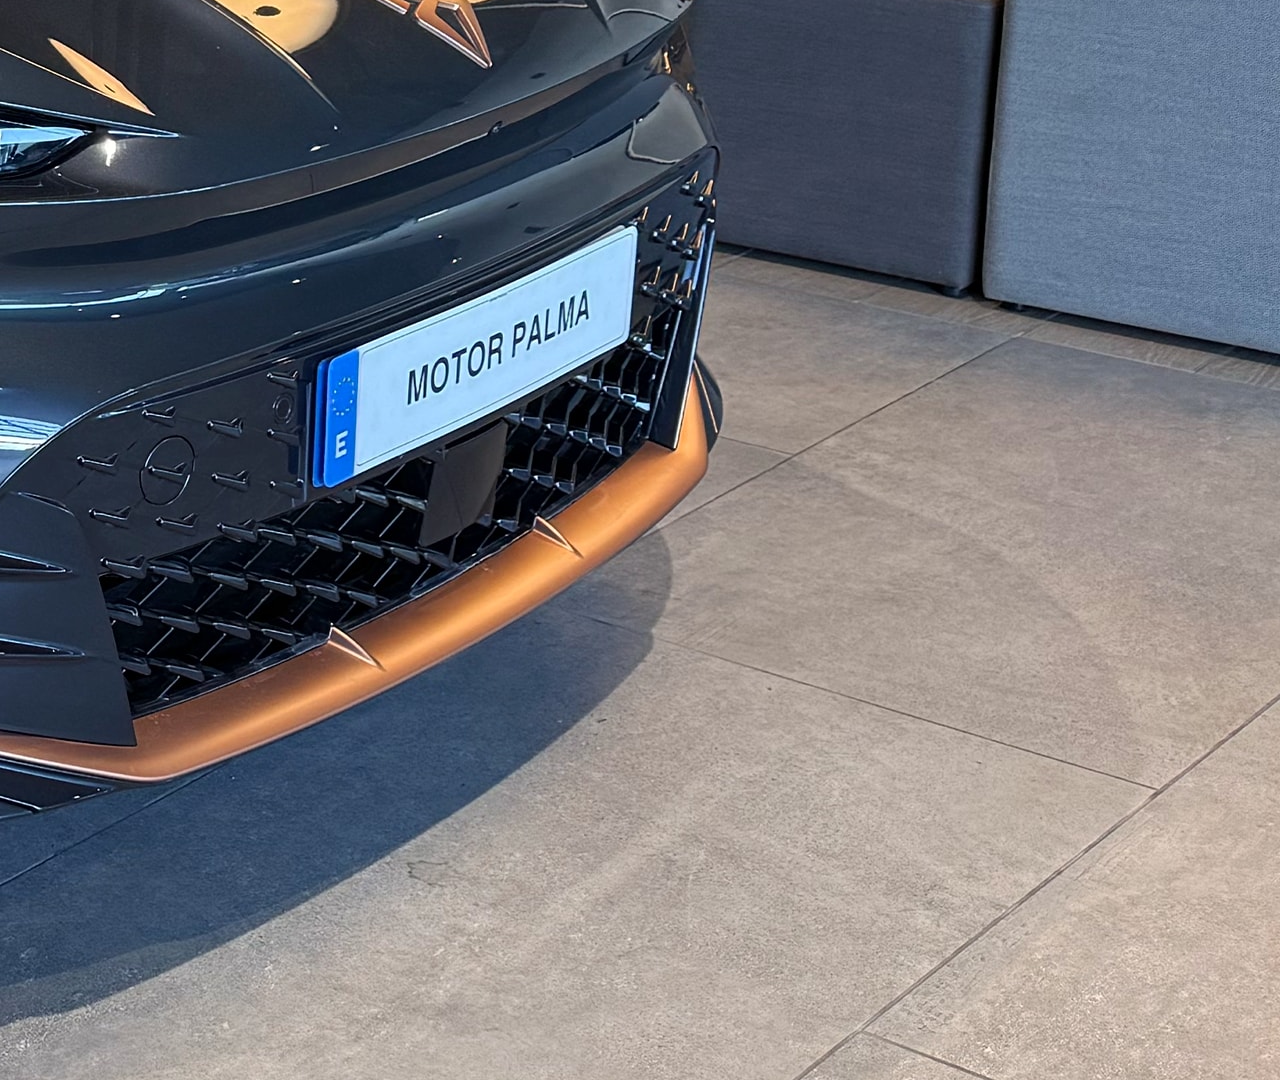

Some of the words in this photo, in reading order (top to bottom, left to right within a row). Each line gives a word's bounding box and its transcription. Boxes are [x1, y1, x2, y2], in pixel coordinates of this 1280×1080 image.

[406, 331, 503, 406] MOTOR
[510, 289, 590, 359] PALMA
[335, 429, 349, 459] E
